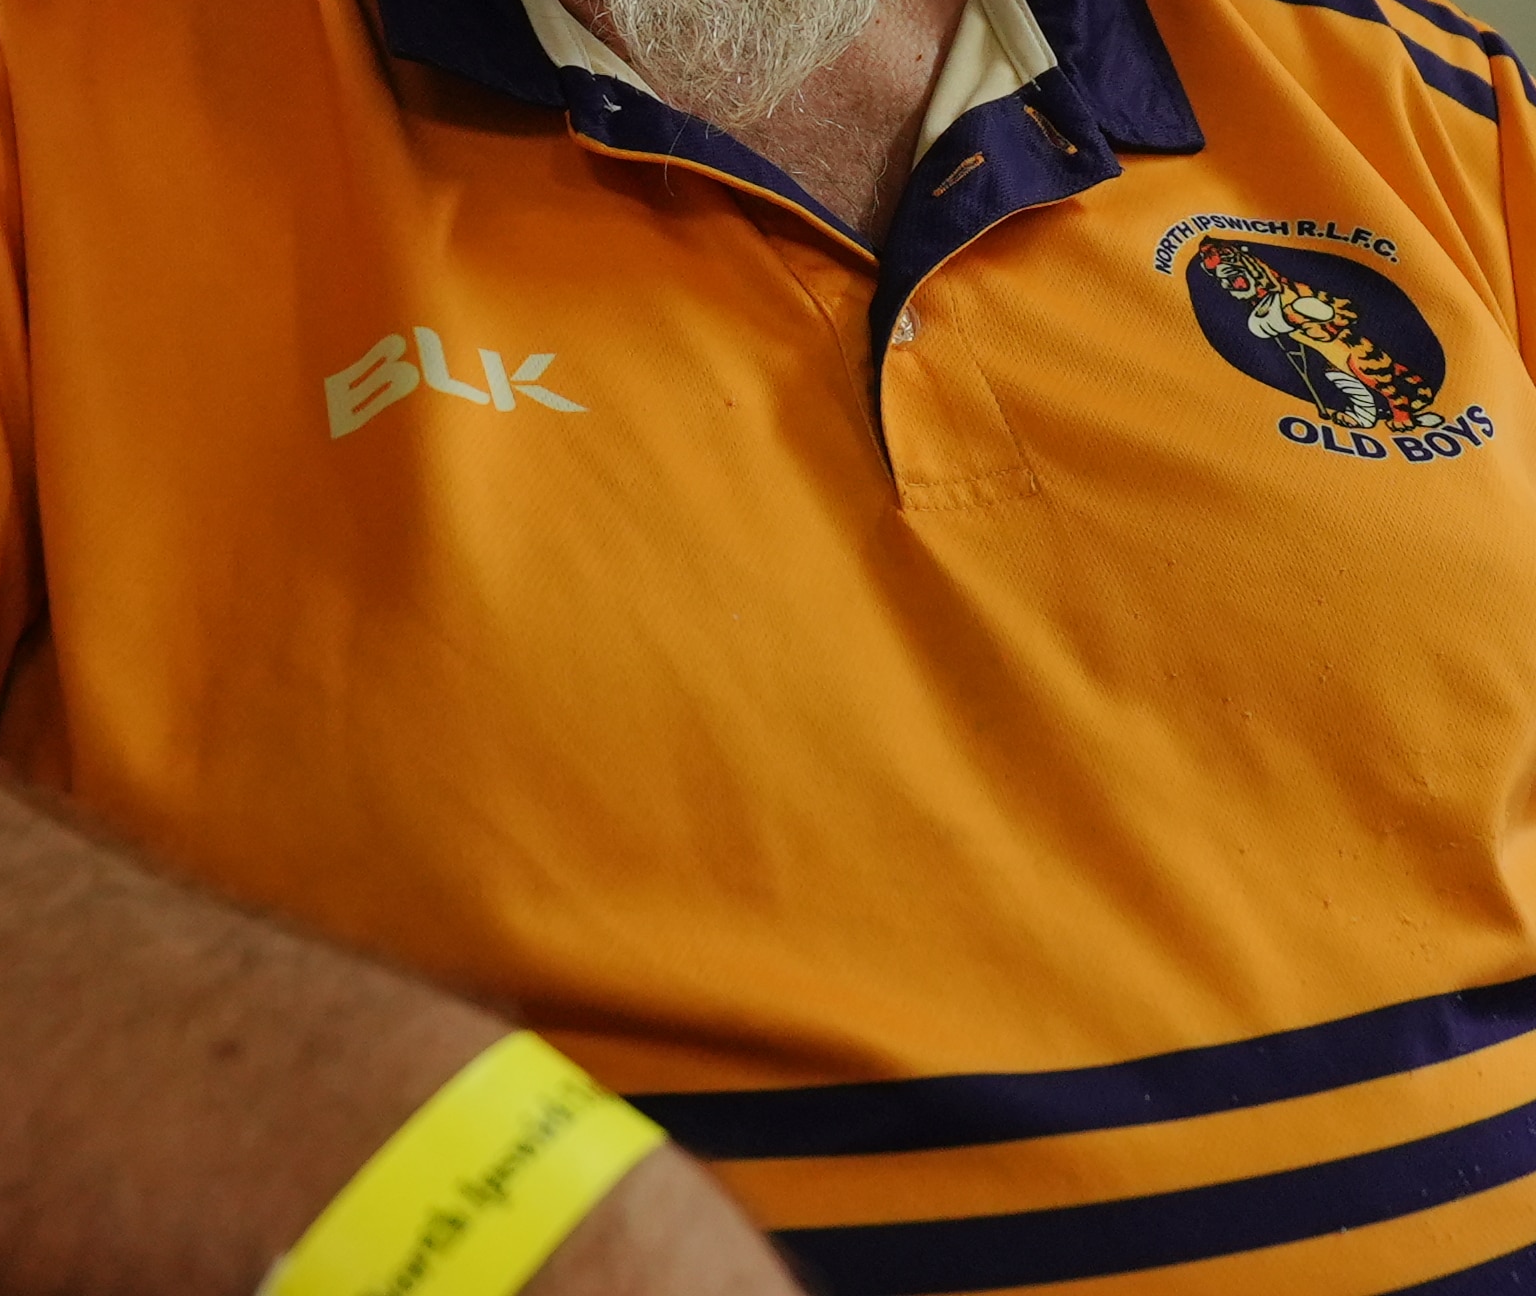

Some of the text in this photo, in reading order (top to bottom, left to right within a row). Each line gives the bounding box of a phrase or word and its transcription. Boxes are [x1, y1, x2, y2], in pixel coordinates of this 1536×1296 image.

[1153, 214, 1400, 276] NORTH IPSWICH R.L.F.C.
[323, 325, 590, 440] BLK
[1278, 404, 1495, 464] OLD BOYS
